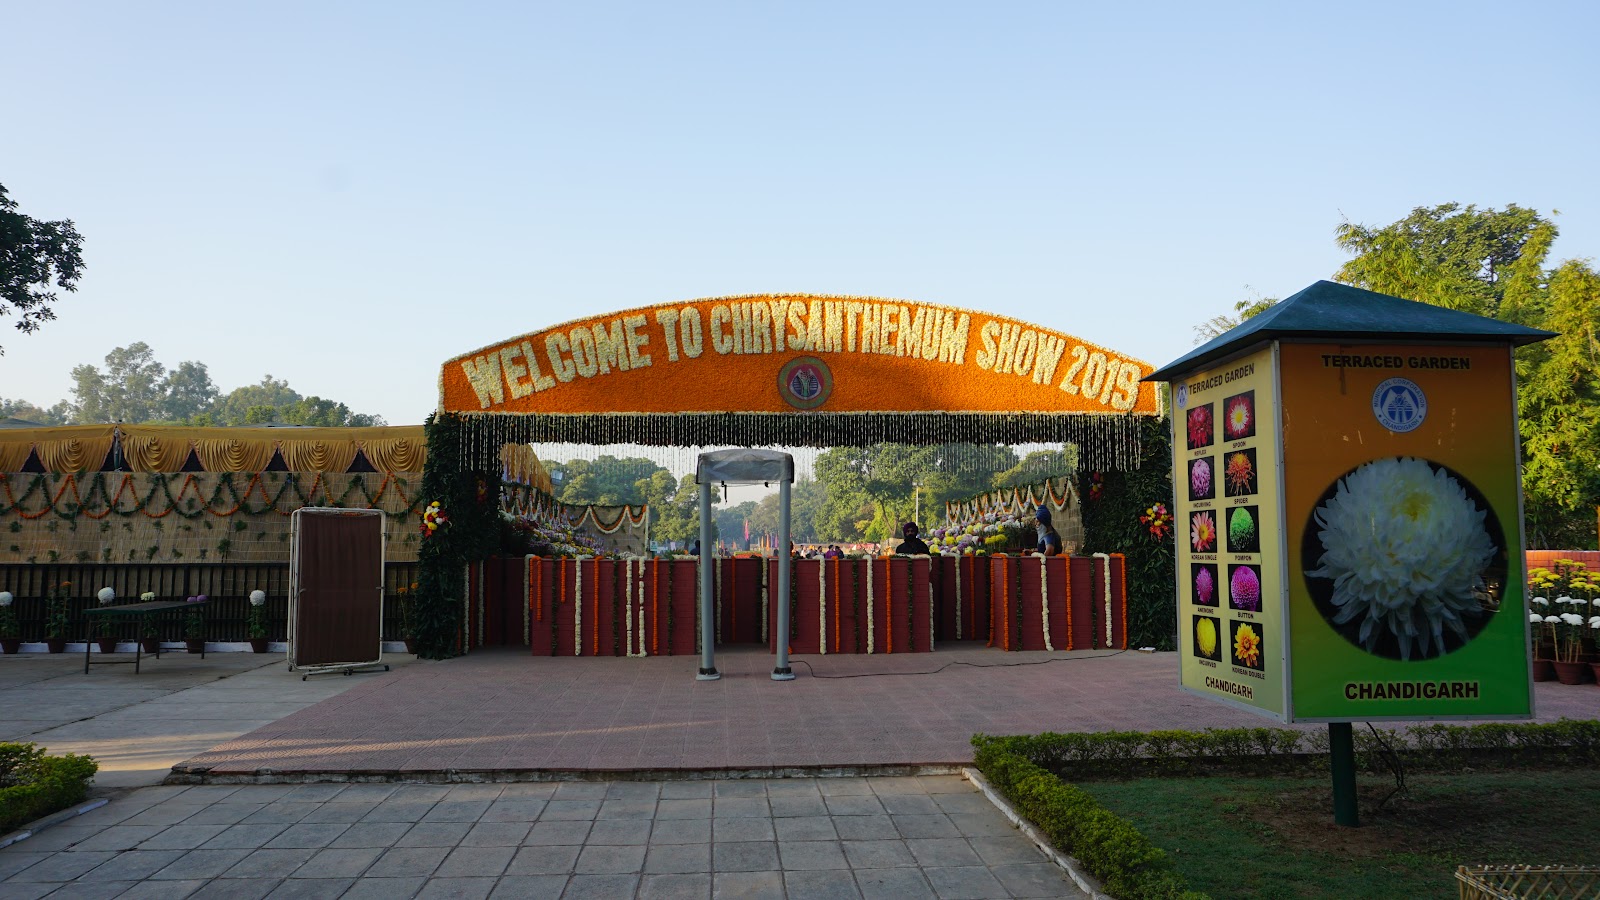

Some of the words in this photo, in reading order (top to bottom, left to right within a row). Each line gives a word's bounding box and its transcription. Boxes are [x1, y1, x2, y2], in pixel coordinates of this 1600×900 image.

[461, 314, 652, 409] WELCOME
[656, 306, 703, 362] TO
[710, 299, 970, 365] CHRYSANTHEMUM
[976, 319, 1066, 385] SHOW
[1059, 346, 1142, 411] 2019
[1321, 354, 1403, 369] TERRACED
[1408, 355, 1471, 370] GARDEN
[1188, 374, 1223, 396] TERRACED
[1224, 362, 1255, 384] GARDEN
[1373, 380, 1392, 408] MUNICIPAL
[1392, 378, 1425, 408] CORPORATION
[1382, 418, 1420, 431] CHANDIGARH
[1232, 440, 1247, 449] SPOON
[1234, 497, 1249, 505] SPIDER
[1237, 611, 1254, 619] BUTTON
[1231, 666, 1248, 676] KOREAN
[1248, 670, 1265, 680] DOUBLE
[1205, 676, 1253, 700] CHANDIGARH
[1345, 682, 1479, 700] CHANDIGARH
